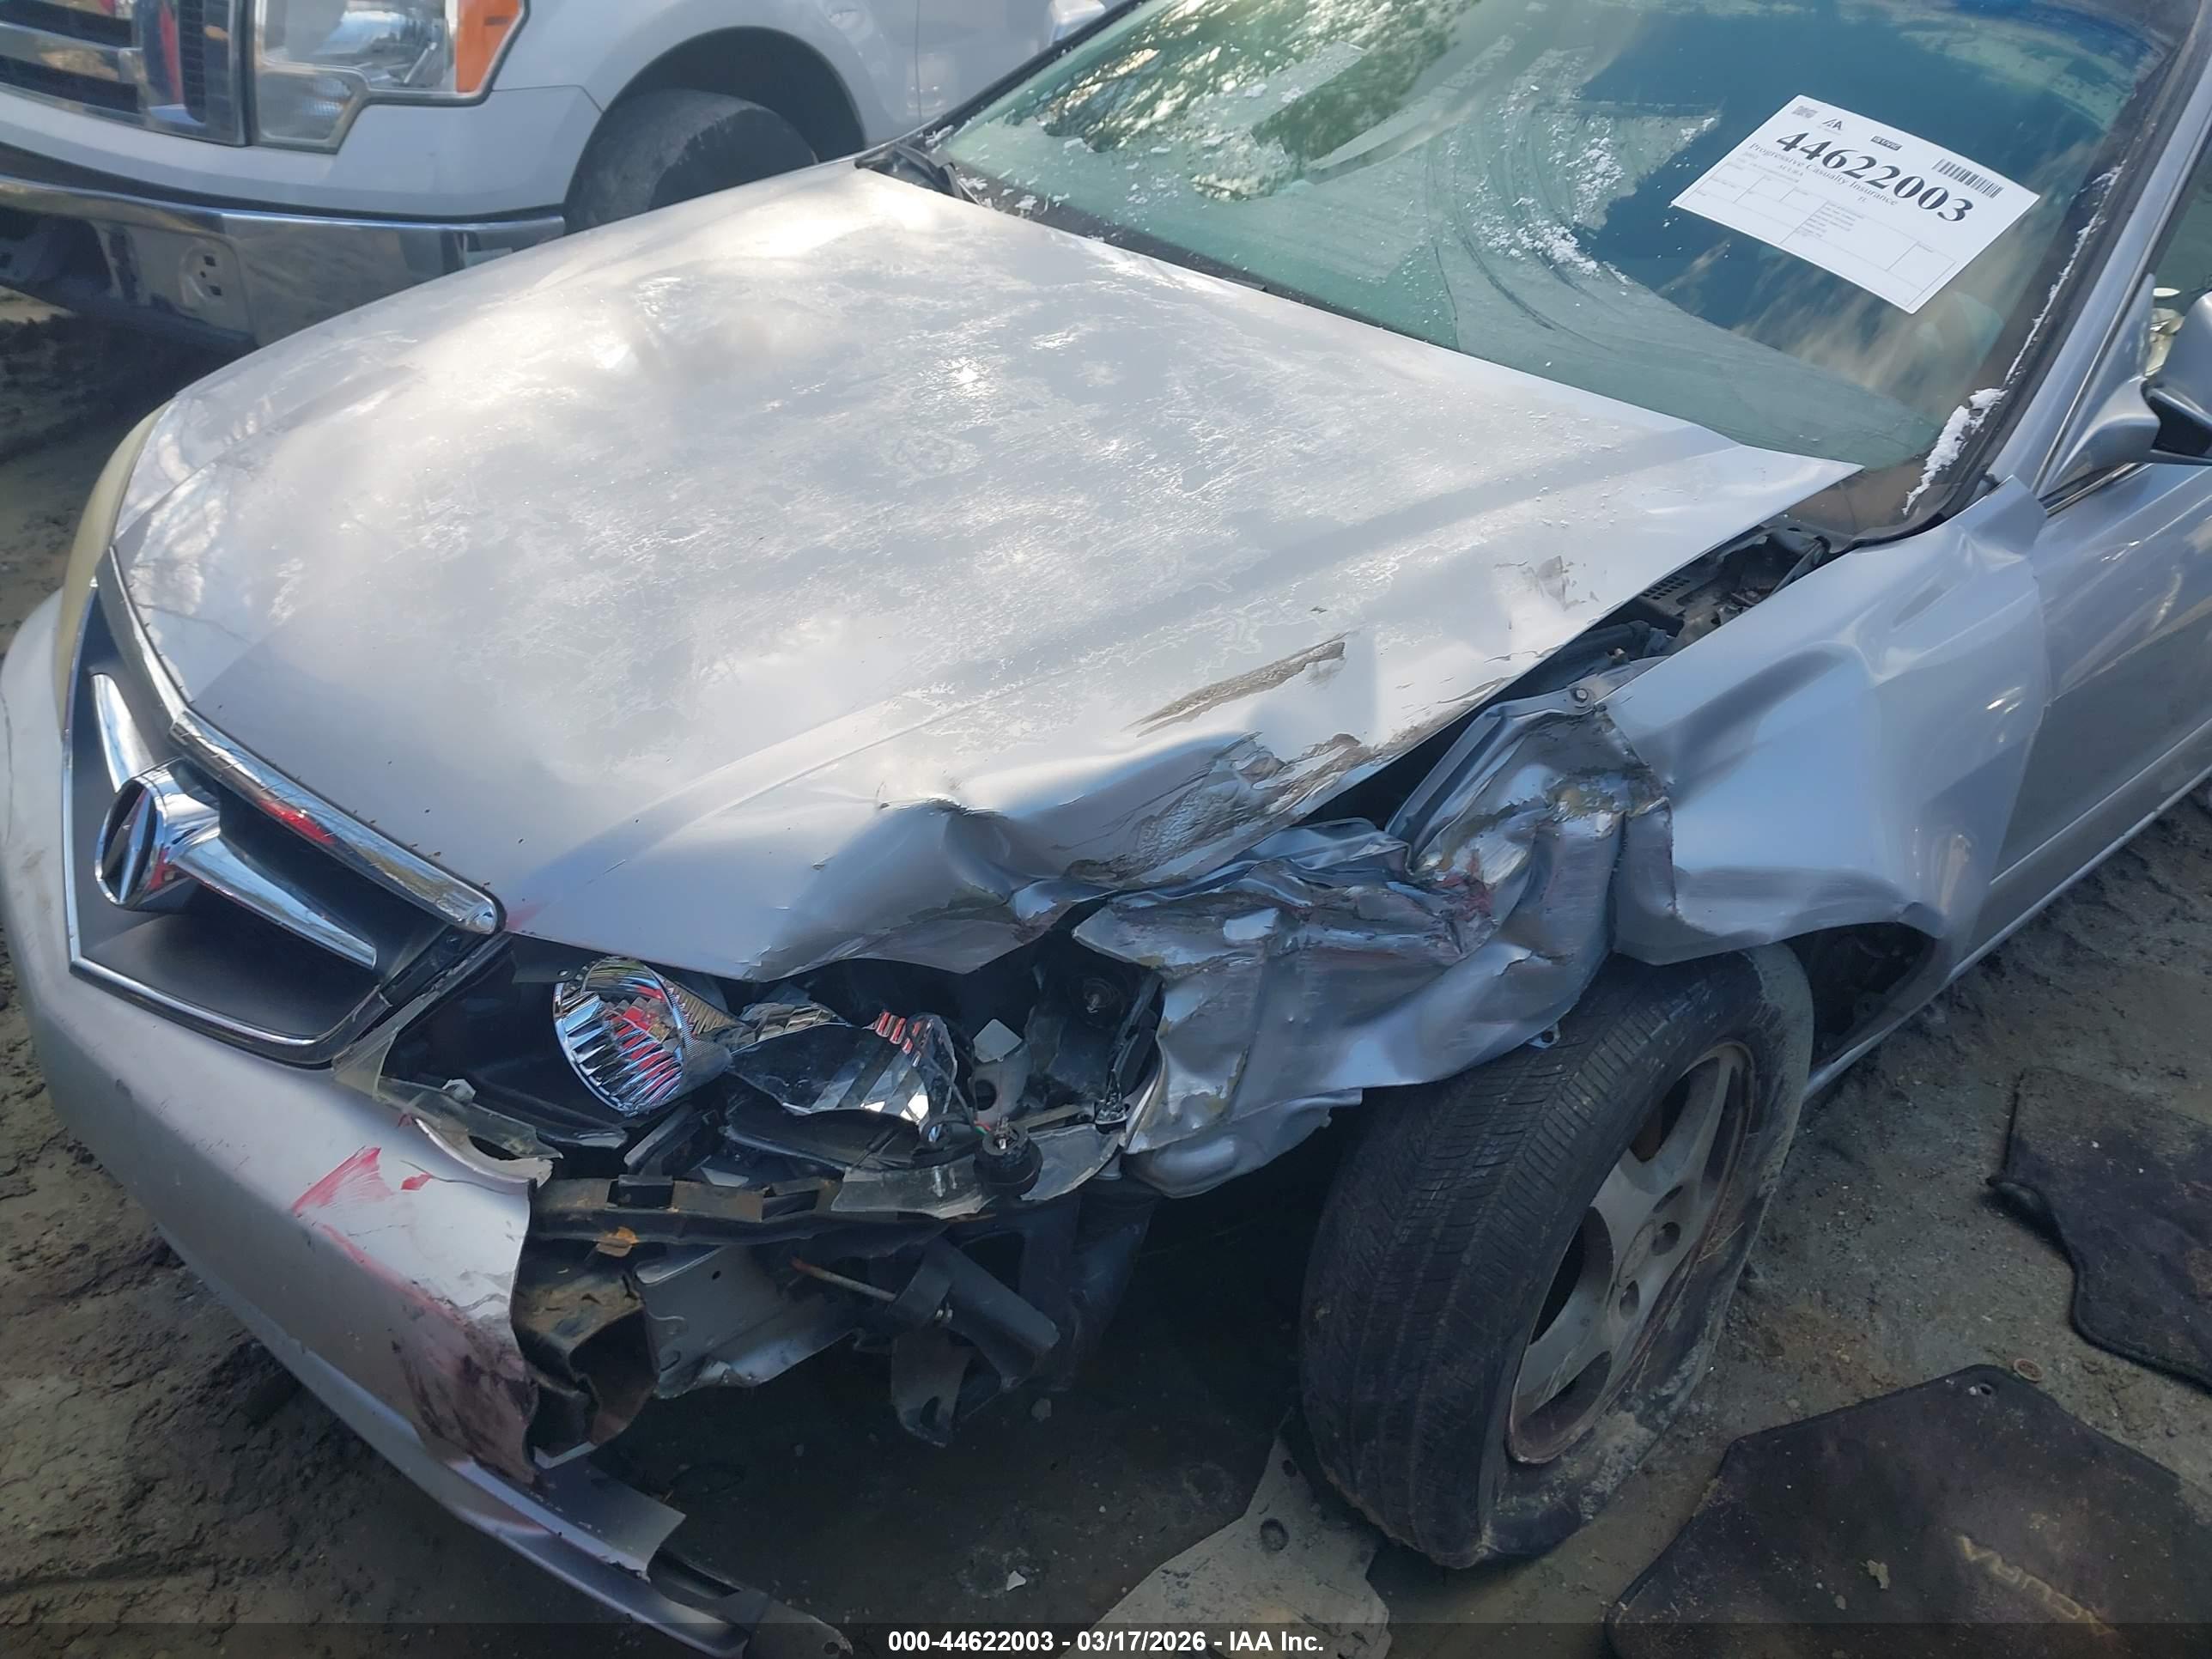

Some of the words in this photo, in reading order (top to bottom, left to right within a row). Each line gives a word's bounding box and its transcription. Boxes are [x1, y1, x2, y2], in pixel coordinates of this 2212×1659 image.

[1748, 143, 1805, 167] Progressive
[1806, 164, 1850, 185] Casualty
[1849, 180, 1899, 206] Insurance
[1775, 131, 1974, 222] 44622003
